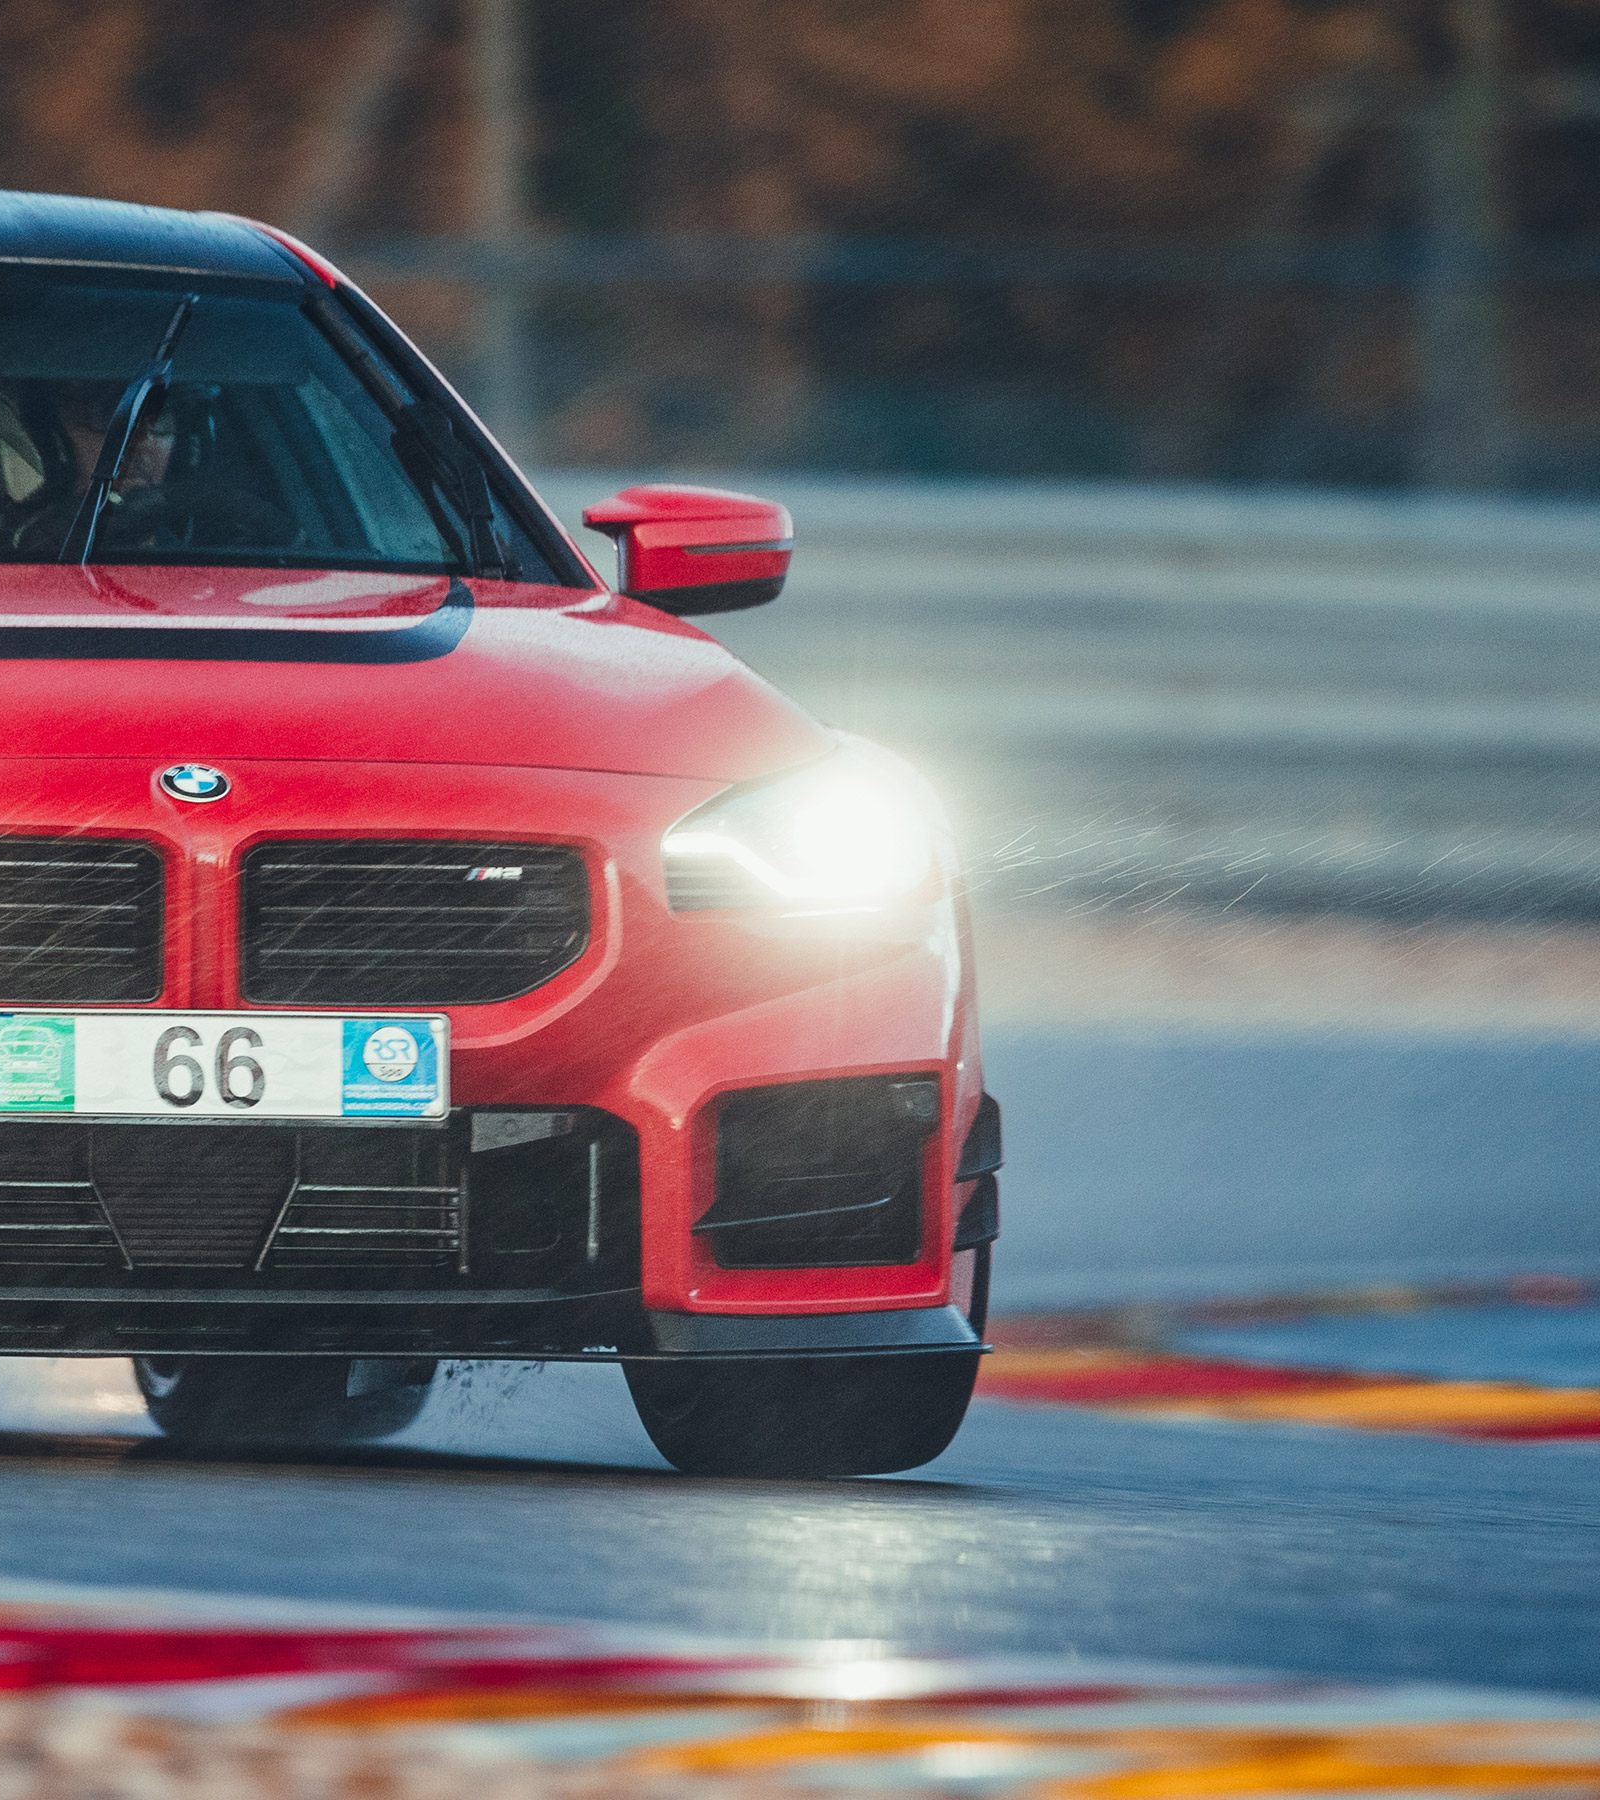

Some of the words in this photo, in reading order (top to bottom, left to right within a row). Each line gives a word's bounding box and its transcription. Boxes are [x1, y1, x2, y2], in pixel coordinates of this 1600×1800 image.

[482, 867, 523, 881] M2
[371, 1039, 411, 1061] RSR
[153, 1025, 265, 1109] 66
[380, 1066, 403, 1080] Spa
